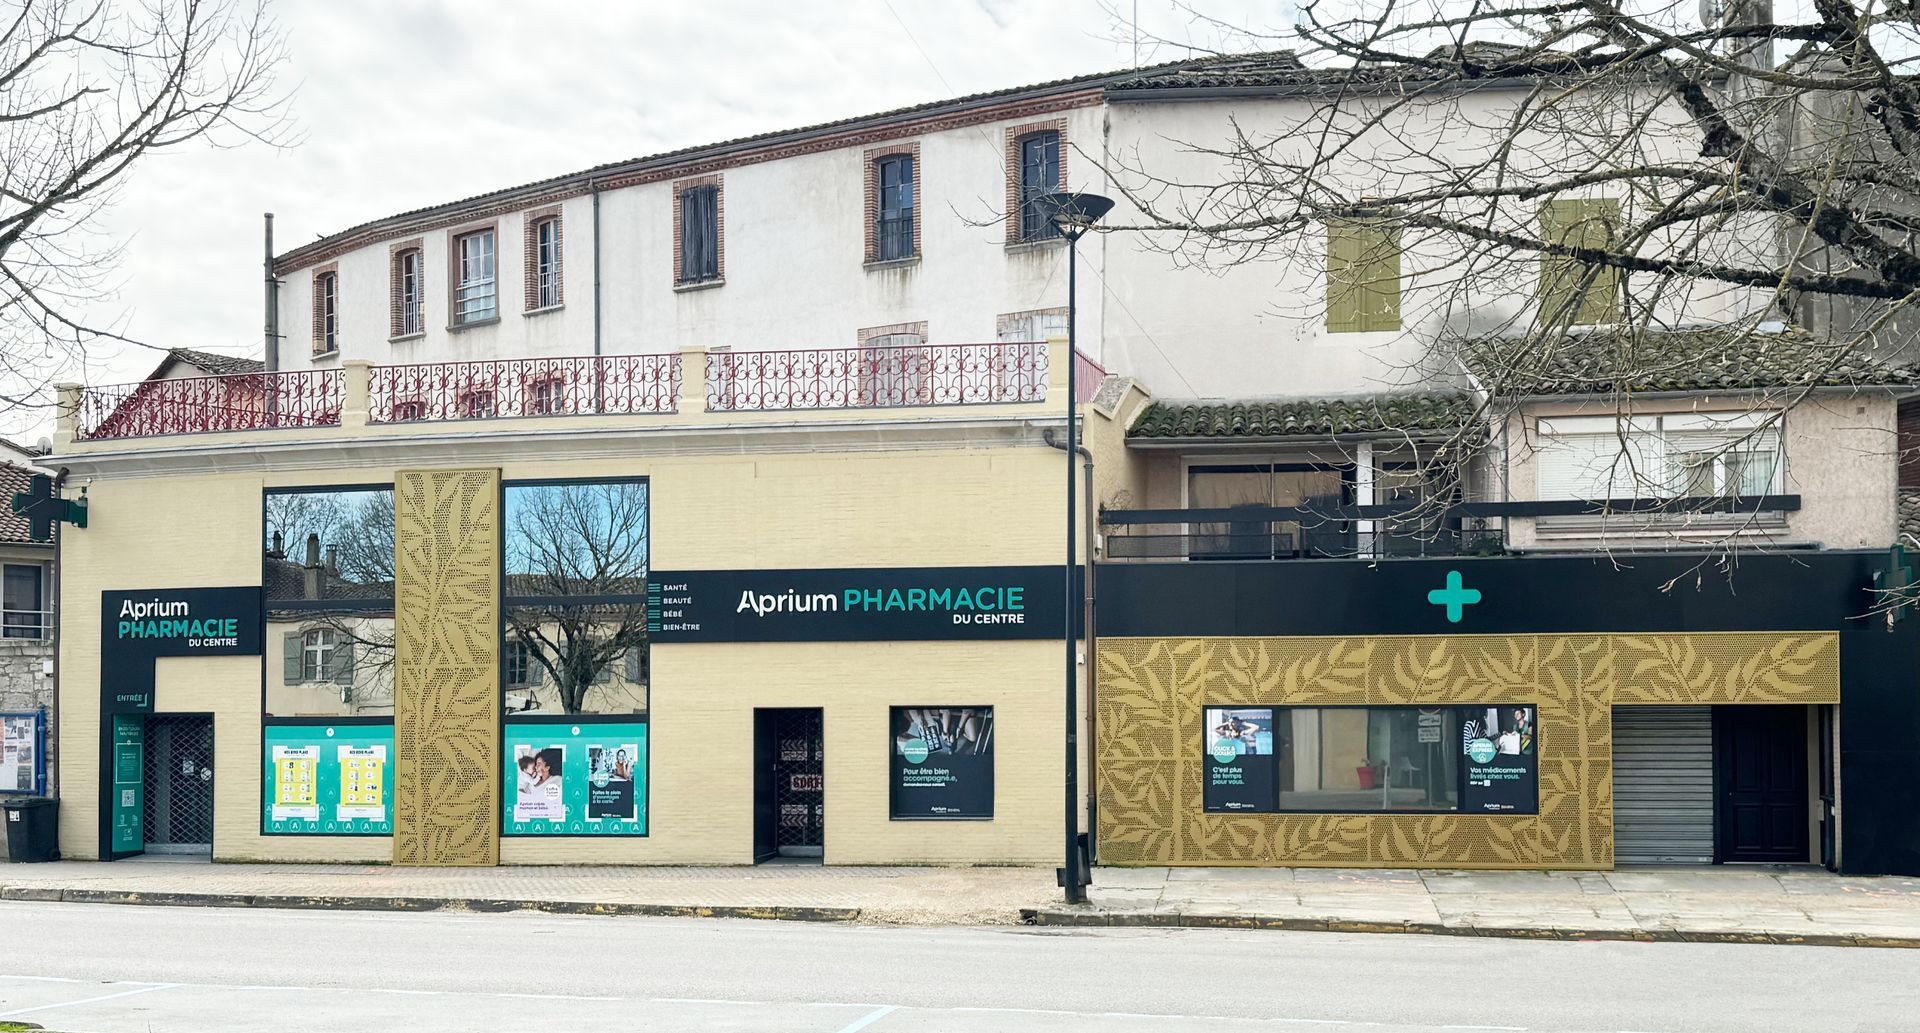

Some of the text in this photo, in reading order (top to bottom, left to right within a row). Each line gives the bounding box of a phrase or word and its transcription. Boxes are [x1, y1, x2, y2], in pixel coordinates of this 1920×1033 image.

[663, 583, 688, 591] SANTÉ
[736, 587, 1025, 617] Aprium PHARMACIE
[119, 598, 189, 621] Aprium
[663, 610, 683, 618] BÉBÉ
[953, 614, 1025, 625] DU CENTRE
[118, 618, 238, 639] PHARMACIE
[663, 623, 700, 631] BIEN-ÊTRE
[188, 638, 238, 647] DU CENTRE
[116, 693, 143, 701] ENTRÉE
